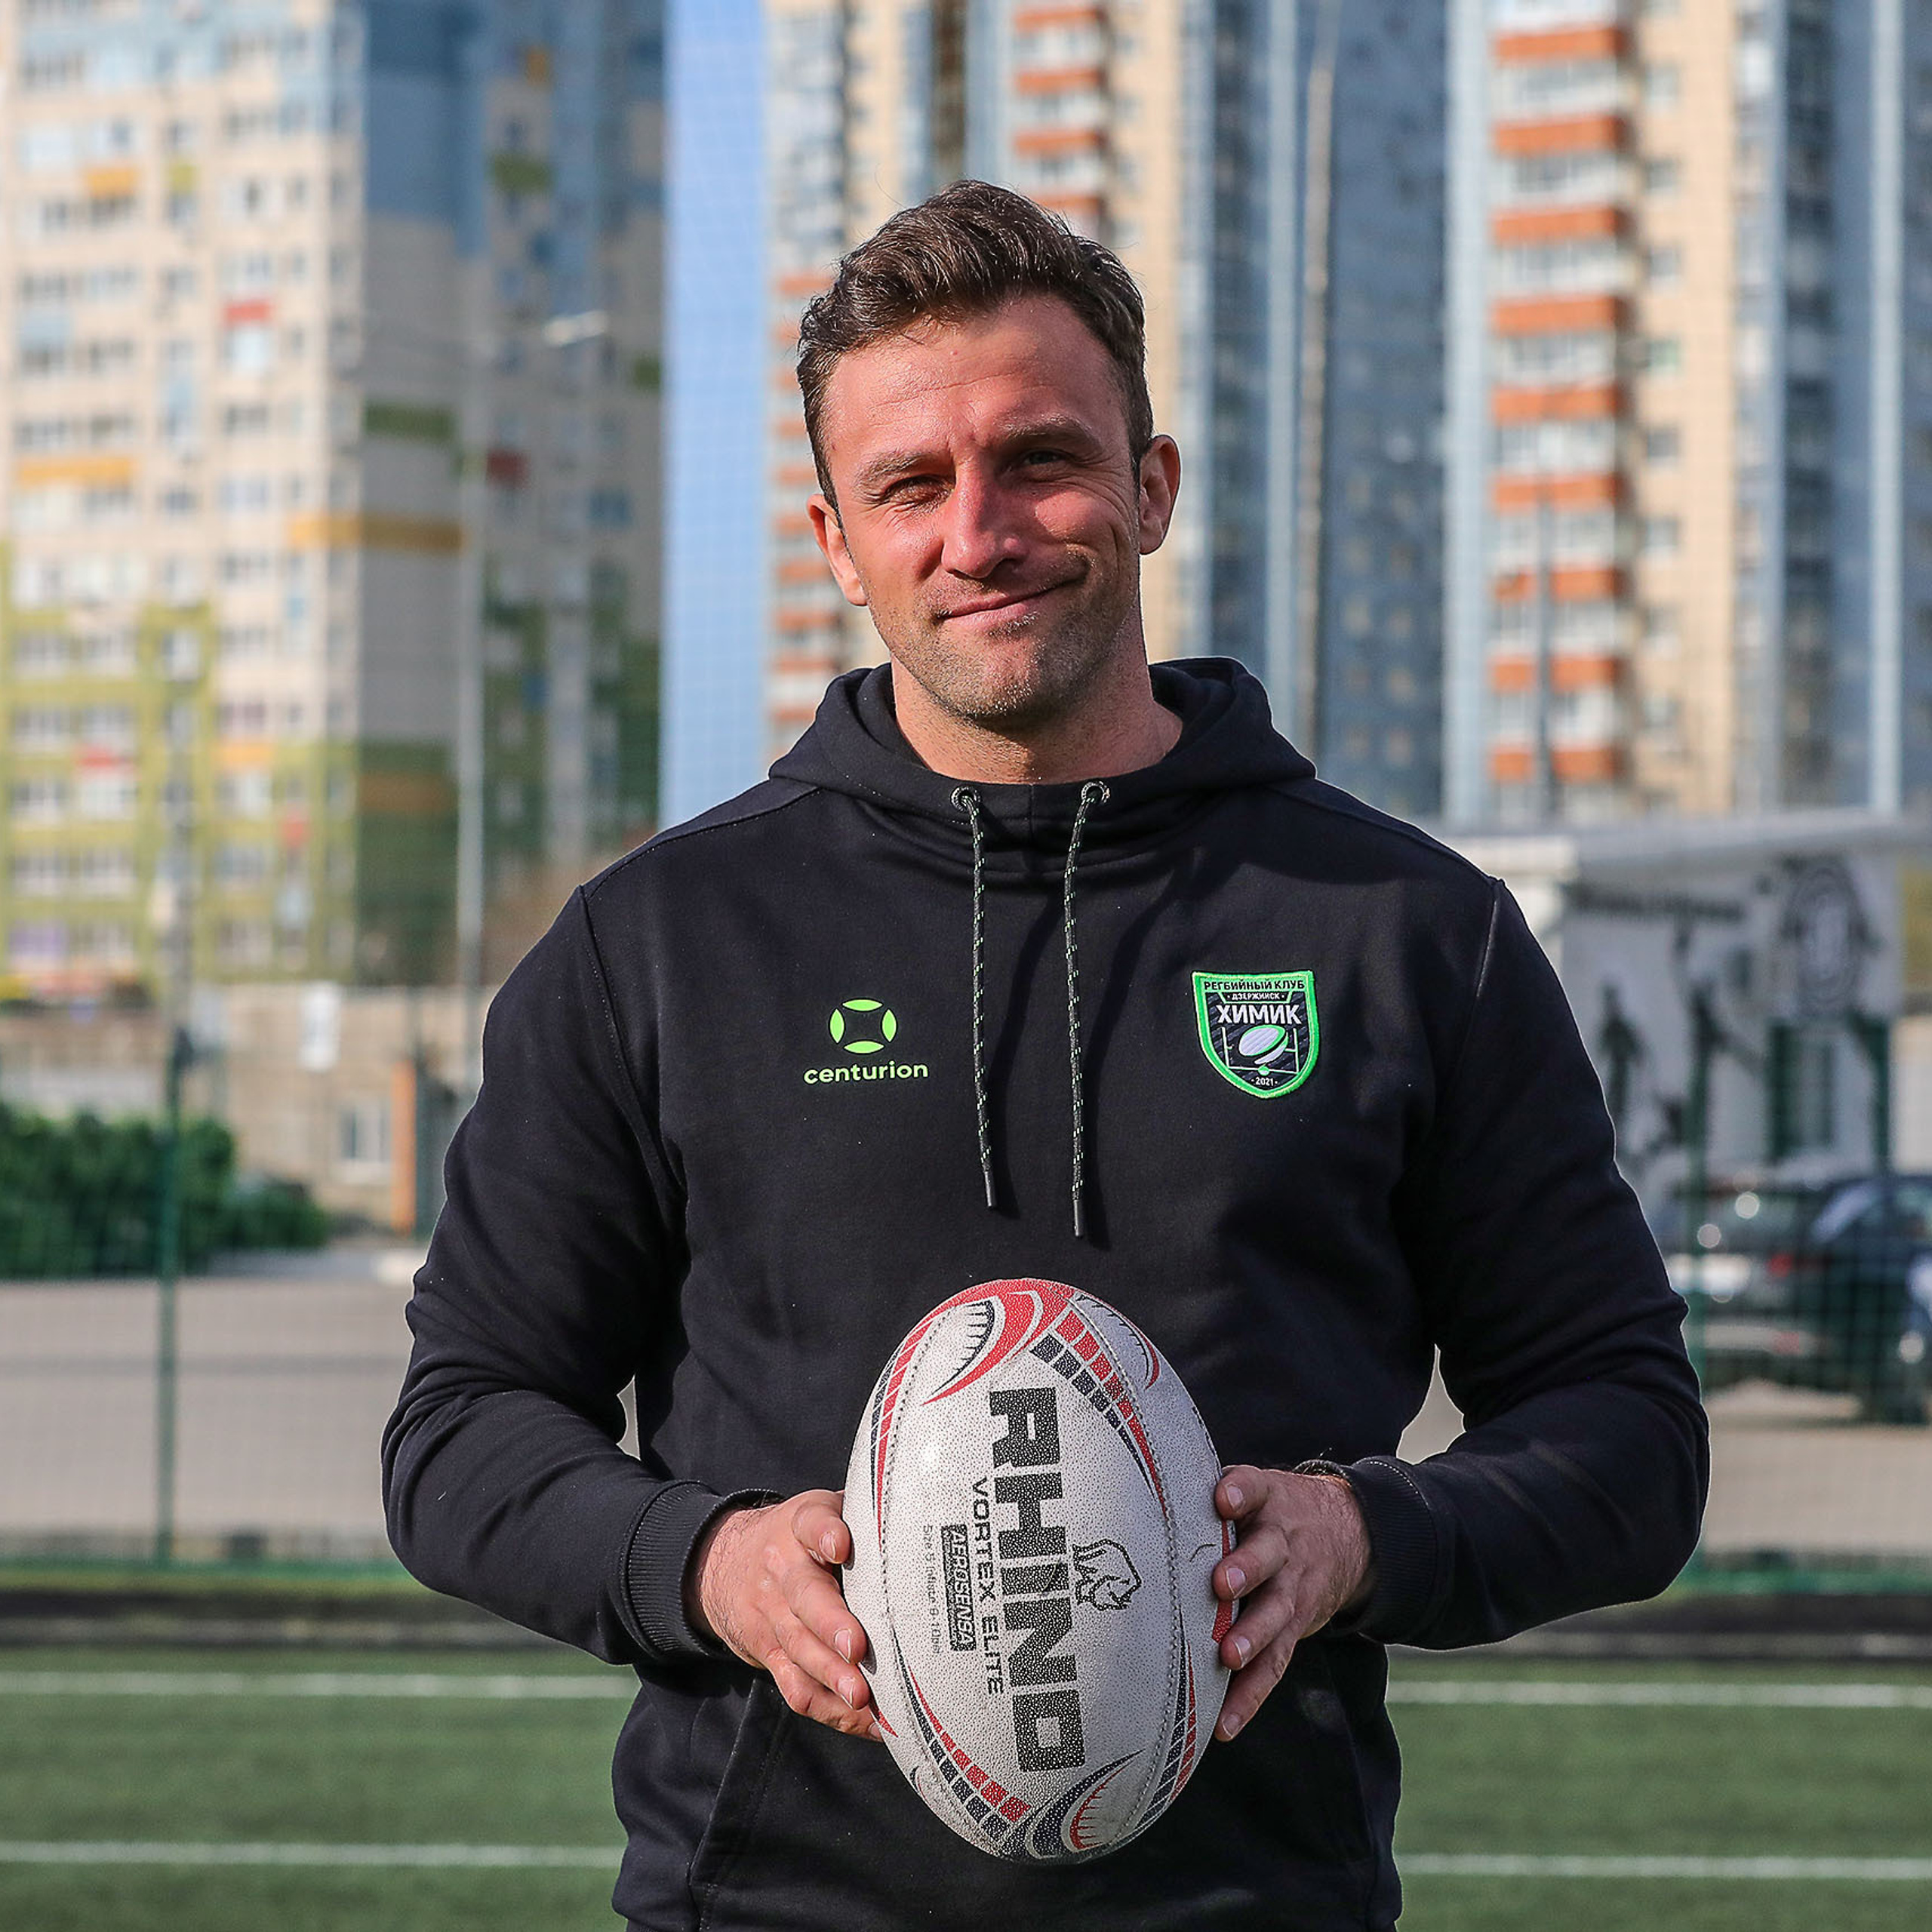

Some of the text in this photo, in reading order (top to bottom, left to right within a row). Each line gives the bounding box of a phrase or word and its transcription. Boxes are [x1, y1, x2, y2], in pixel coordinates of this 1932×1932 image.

[1204, 979, 1305, 990] РЕГБИЙНЫЙ КЛУБ
[1232, 992, 1281, 1001] ДЗЕРЖИНСК
[1216, 1004, 1302, 1024] ХИМИК
[804, 1060, 929, 1084] centurion
[1255, 1076, 1274, 1087] 2021
[951, 1528, 974, 1645] AEROSENSA
[972, 1476, 1004, 1694] VORTEX ELITE
[989, 1386, 1086, 1773] RHINO
